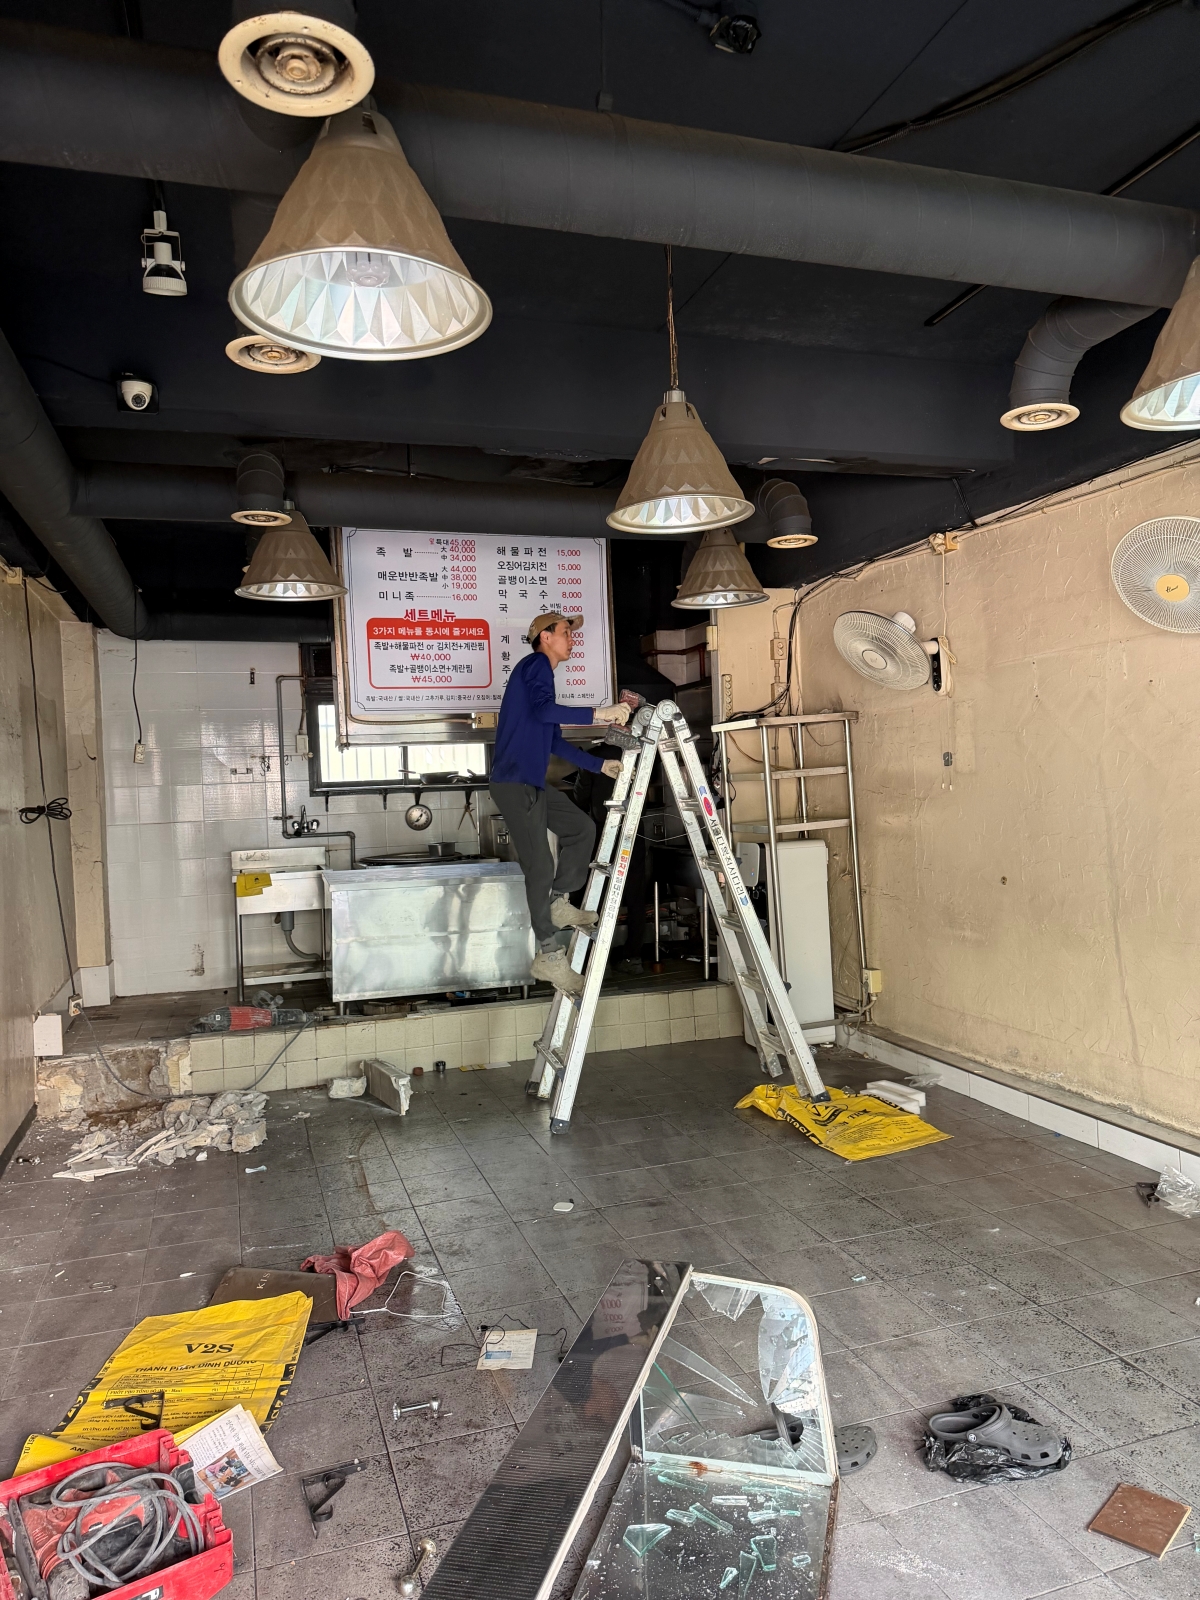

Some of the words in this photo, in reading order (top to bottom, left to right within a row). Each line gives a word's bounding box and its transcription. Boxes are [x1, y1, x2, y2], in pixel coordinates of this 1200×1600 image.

[450, 546, 476, 554] 40,000
[497, 561, 547, 572] 오징어김치전
[377, 571, 439, 582] 매운반반족발
[498, 575, 548, 586] 골뱅이소면
[404, 608, 456, 622] 세트메뉴
[373, 627, 395, 636] 3가지
[398, 627, 423, 636] 메뉴를
[425, 627, 450, 636] 동시에
[452, 627, 485, 636] 즐기세요
[374, 642, 424, 651] 족발+해물파전
[410, 653, 451, 662] ₩40,000
[411, 675, 452, 684] ₩45,000
[185, 1343, 234, 1354] V2S
